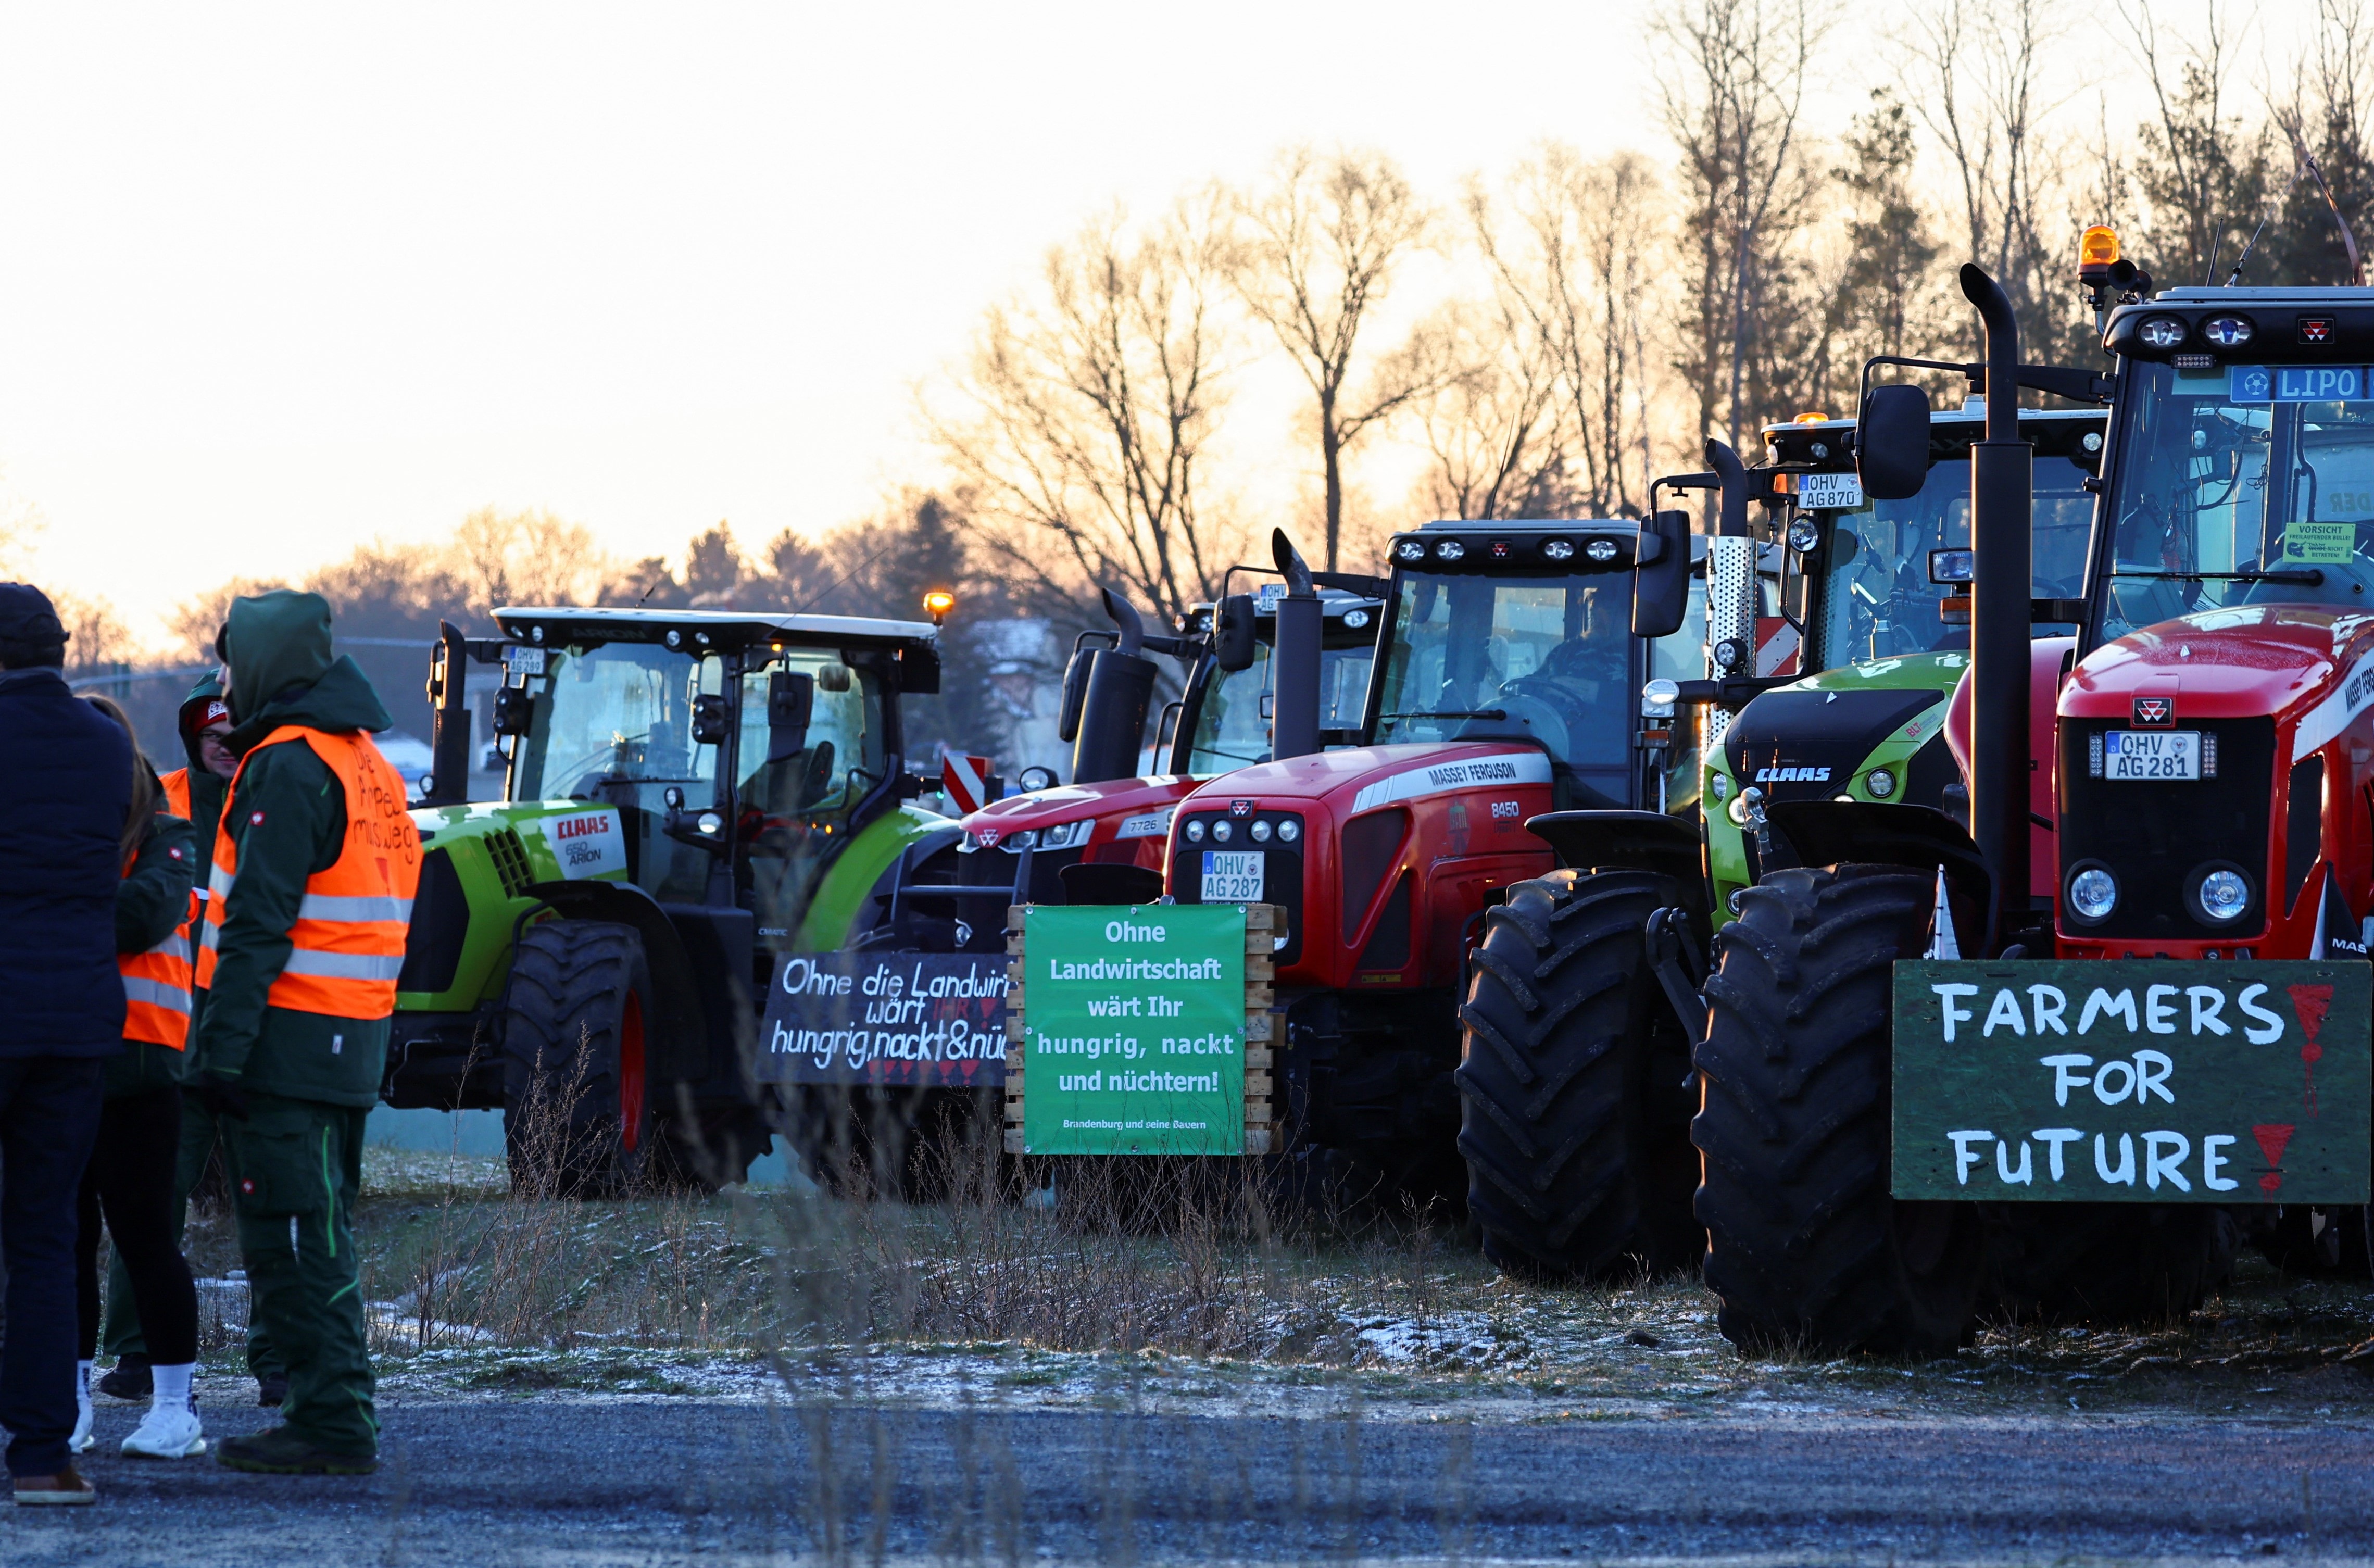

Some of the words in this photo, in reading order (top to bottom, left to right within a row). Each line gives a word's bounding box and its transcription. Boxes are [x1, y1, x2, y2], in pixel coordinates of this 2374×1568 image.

[2282, 369, 2355, 397] LIPO
[1810, 475, 1838, 490] OHV
[1806, 492, 1825, 507] AG
[1828, 491, 1854, 506] 870
[2299, 525, 2343, 534] VORSICHT
[523, 660, 540, 671] 289
[1905, 722, 1922, 737] BLT
[2121, 735, 2163, 755] OHV
[1428, 765, 1468, 787] MASSEY
[1468, 762, 1516, 781] FERGUSON
[1755, 767, 1831, 782] CLAAS
[2116, 757, 2144, 776] AG
[2147, 757, 2189, 777] 281
[1491, 801, 1519, 818] 8450
[557, 815, 609, 840] CLAAS
[1131, 819, 1157, 832] 7726
[566, 841, 588, 856] 650
[569, 849, 601, 867] ARION
[1214, 856, 1245, 875] OHV
[1205, 876, 1226, 897] AG
[1230, 878, 1261, 898] 287
[1106, 921, 1166, 942] Ohne
[783, 959, 852, 995] Ohne
[862, 963, 903, 997] die
[1050, 958, 1222, 980] Landwirtschaft
[865, 997, 926, 1024] wärt
[1087, 995, 1141, 1017] wärt
[1147, 995, 1183, 1017] Ihr
[1038, 1033, 1146, 1059] hungrig,
[1162, 1033, 1234, 1055] nackt
[1059, 1070, 1101, 1092] und
[1109, 1070, 1219, 1092] nüchtern!
[2040, 1049, 2175, 1107] FOR
[1063, 1119, 1124, 1130] Brandenburg
[1125, 1120, 1144, 1128] und
[1145, 1121, 1171, 1129] seine
[1173, 1121, 1206, 1130] Bauern
